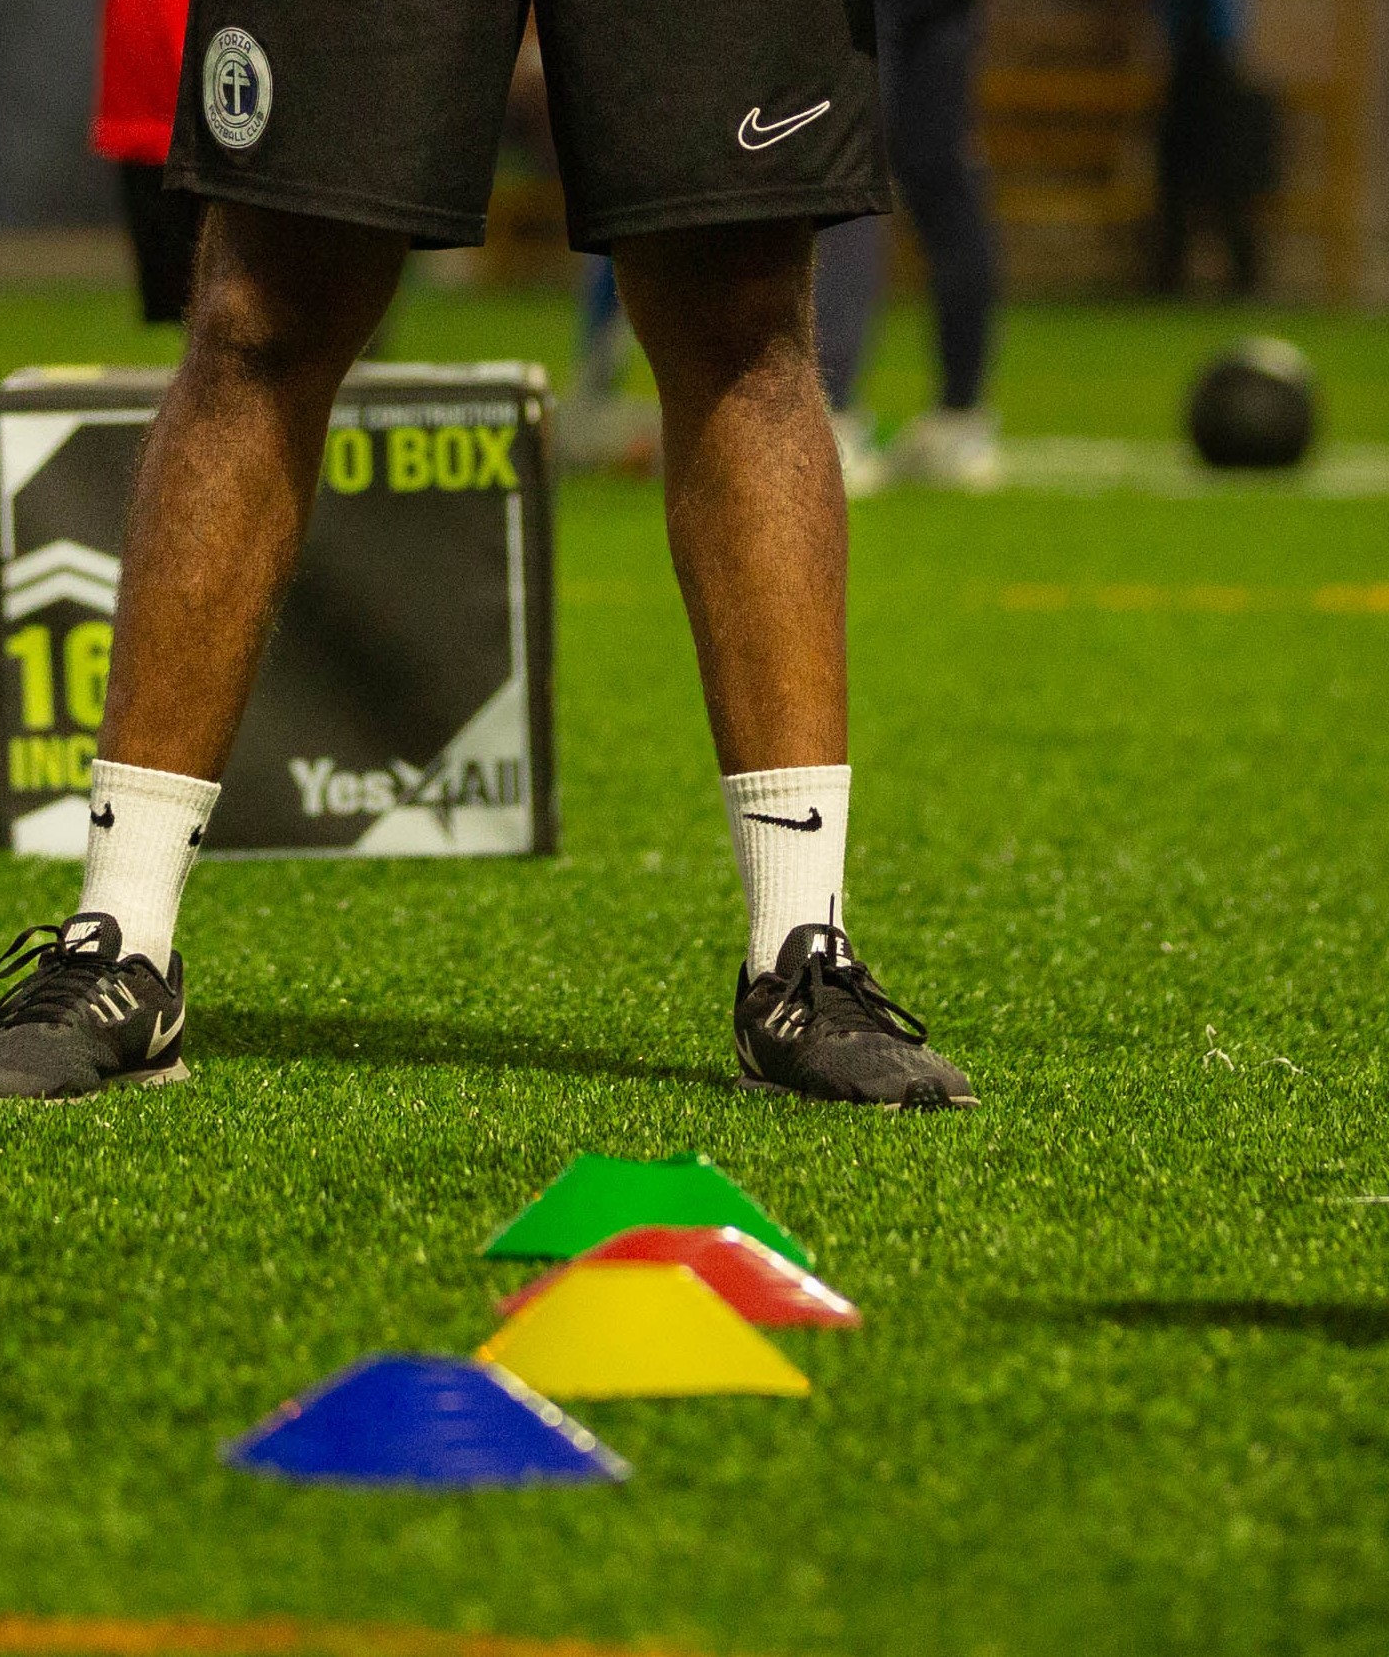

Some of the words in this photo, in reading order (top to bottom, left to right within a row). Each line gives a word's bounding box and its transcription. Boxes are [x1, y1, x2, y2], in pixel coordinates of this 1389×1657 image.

[219, 34, 251, 54] FORZA
[209, 105, 246, 141] FOOTBALL
[247, 111, 264, 136] CLUB
[387, 425, 519, 490] BOX
[3, 619, 114, 730] 16
[811, 933, 845, 956] NIE
